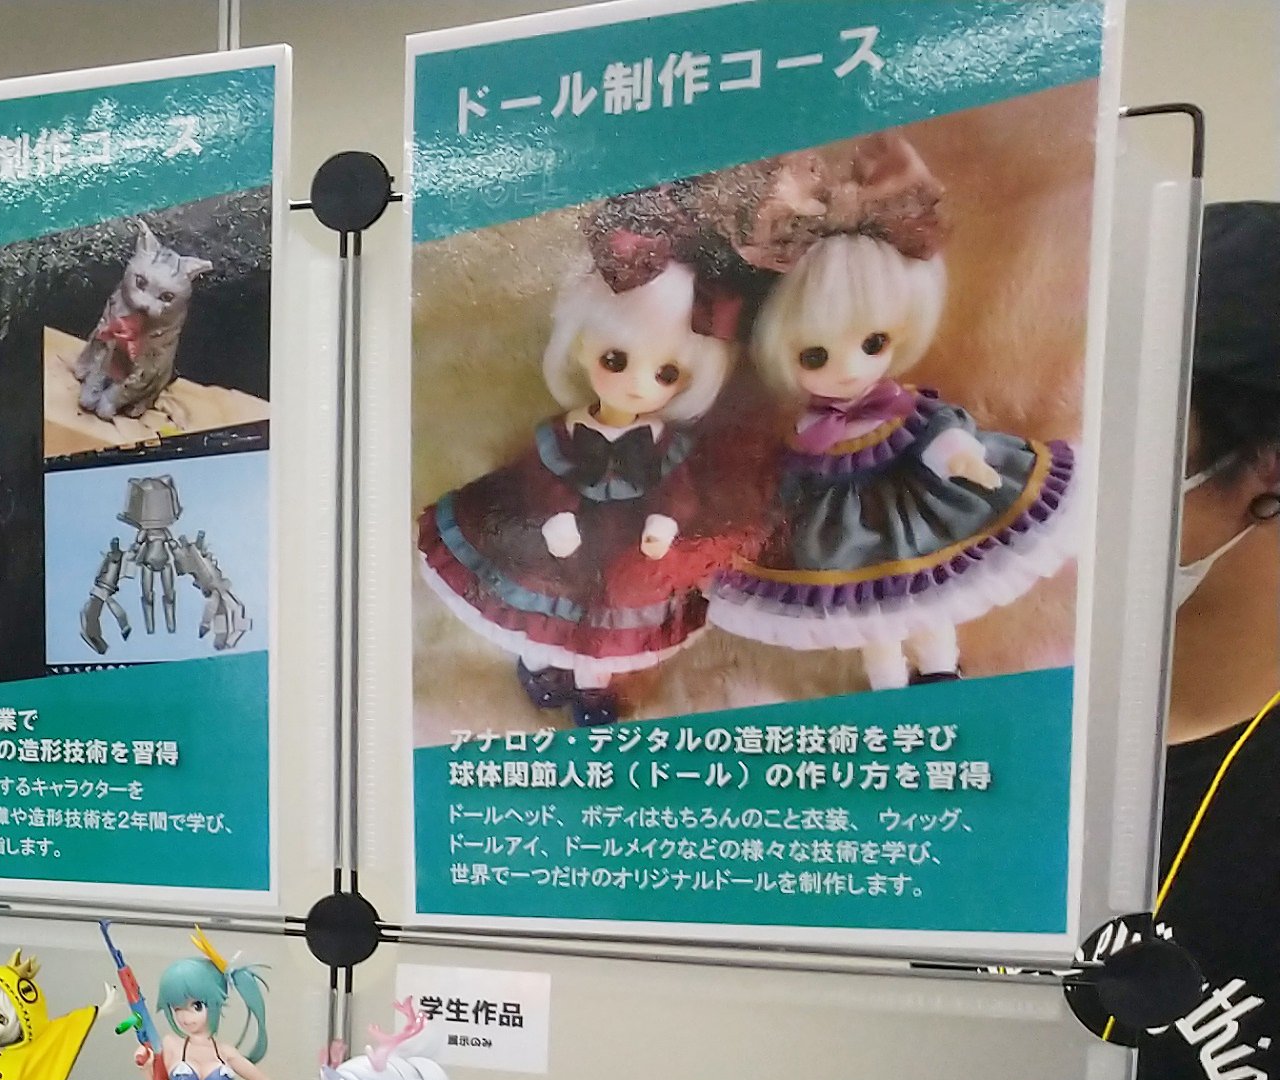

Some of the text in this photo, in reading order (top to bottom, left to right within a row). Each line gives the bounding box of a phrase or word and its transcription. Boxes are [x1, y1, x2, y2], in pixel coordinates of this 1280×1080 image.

[457, 26, 886, 134] ドール制作コース
[448, 724, 958, 753] アナログ・デジタルの造形技術を学び
[448, 759, 993, 791] 球体関節人形（ドール）の作り方を習得
[449, 863, 924, 898] 世界で一つだけのオリジナルドールを制作します。
[419, 995, 524, 1028] 学生作品
